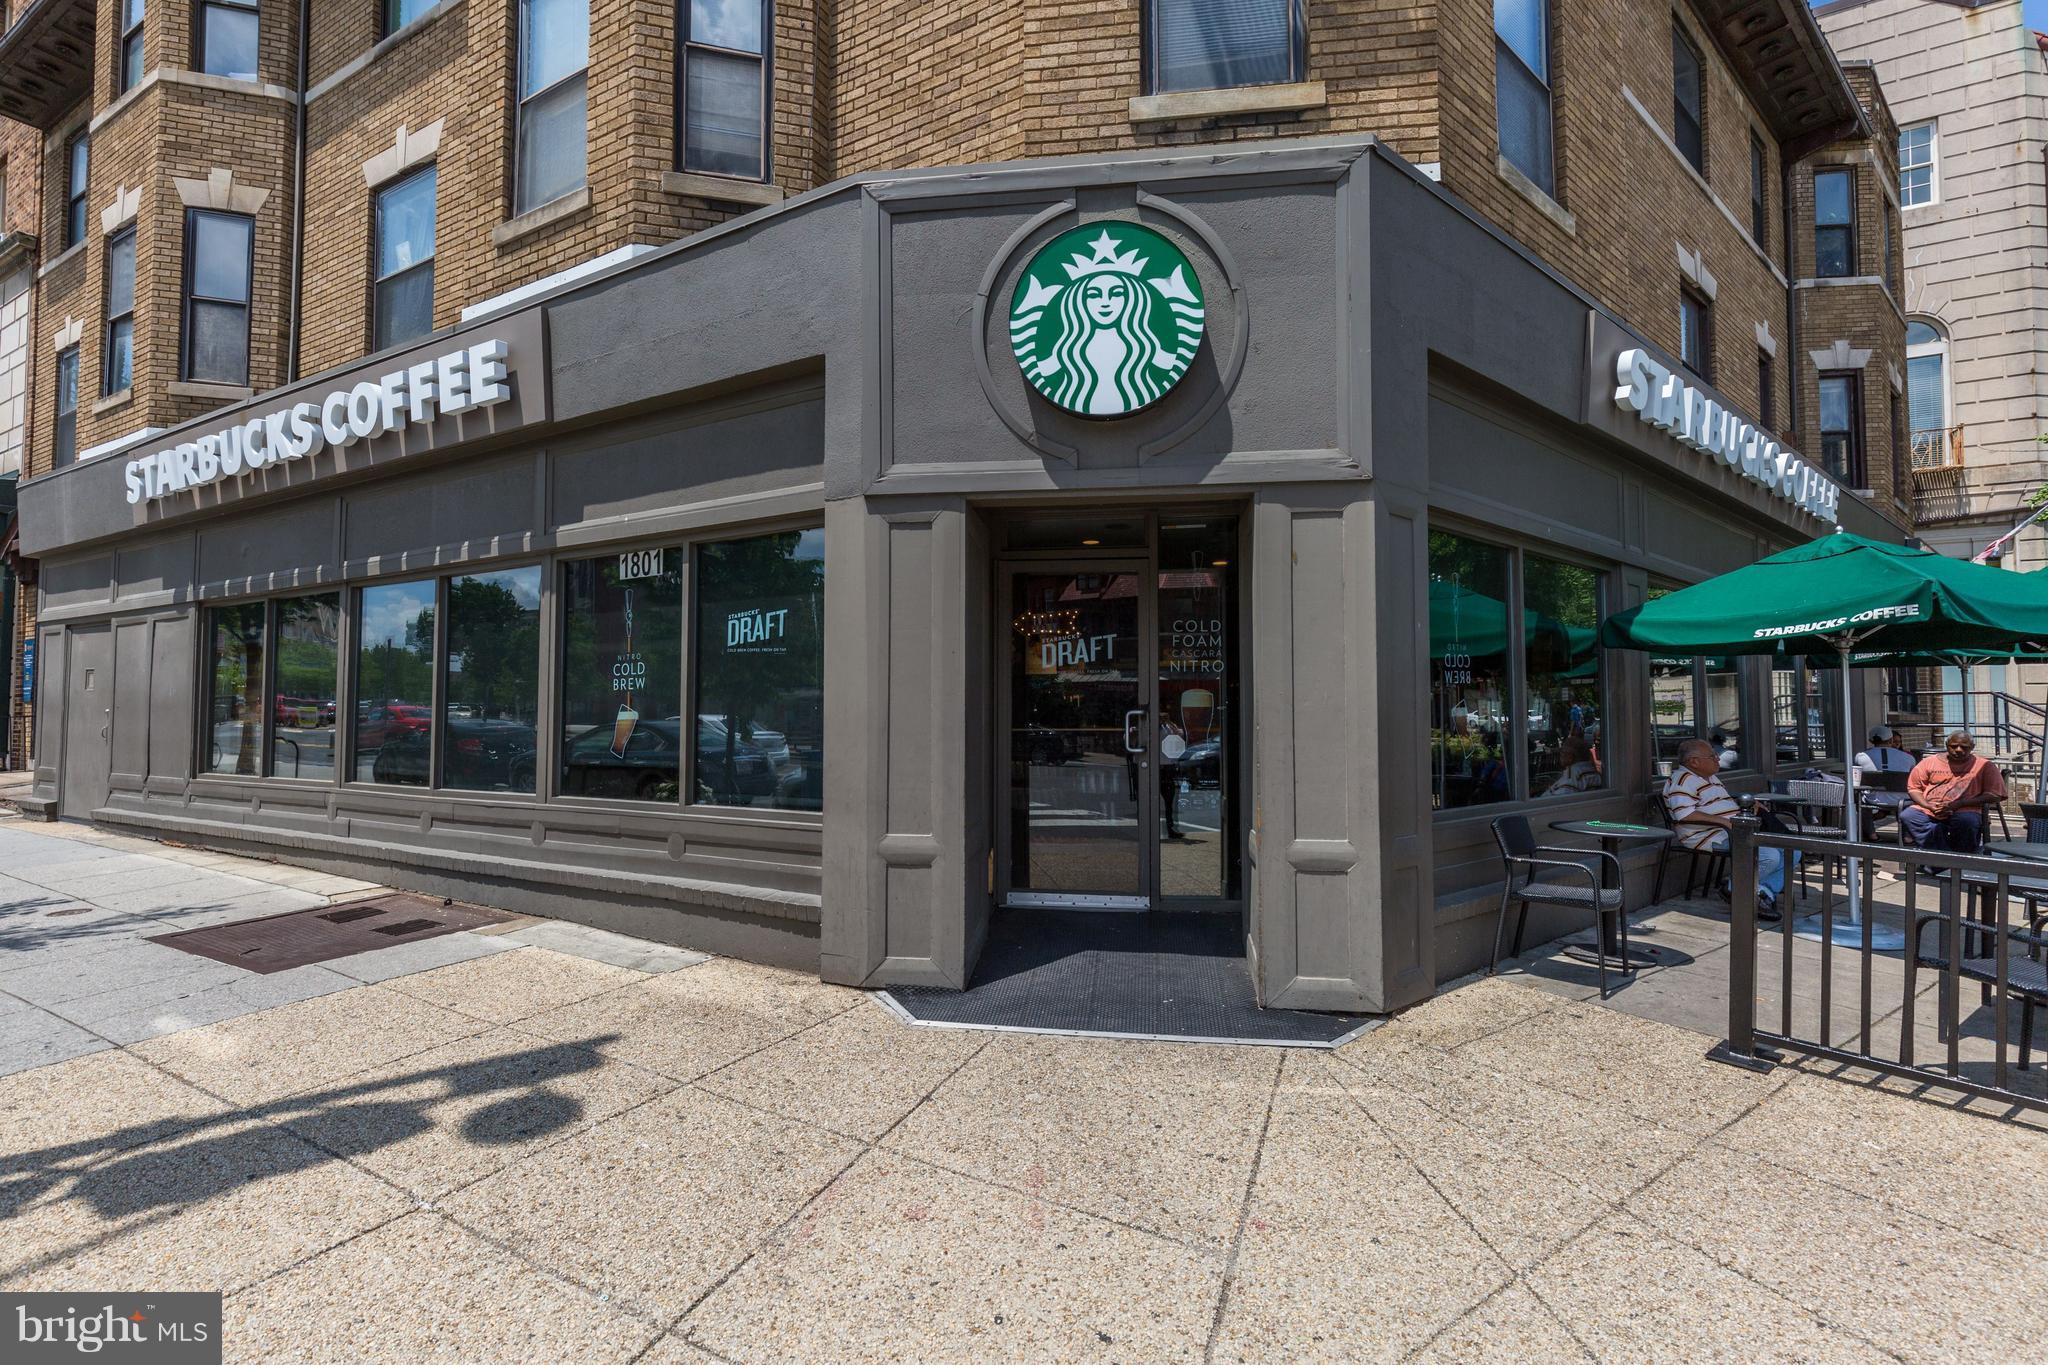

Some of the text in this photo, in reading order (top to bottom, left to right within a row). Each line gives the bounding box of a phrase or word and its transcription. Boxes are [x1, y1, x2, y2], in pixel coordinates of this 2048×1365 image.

[125, 338, 510, 504] STARBUCKS COFFEE
[1615, 348, 1781, 489] STARBUCKS
[621, 549, 661, 578] 1801
[728, 608, 760, 620] STARBUCKS
[1753, 603, 1920, 638] STARBUCKS COFFEE
[728, 609, 788, 647] DRAFT
[1172, 619, 1222, 633] COLD
[1172, 634, 1222, 647] FOAM
[617, 653, 642, 661] NITRO
[1041, 633, 1118, 669] DRAFT
[1172, 649, 1222, 658] CASCARA
[613, 662, 646, 676] COLD
[1170, 660, 1225, 673] NITRO
[613, 677, 646, 691] BREW
